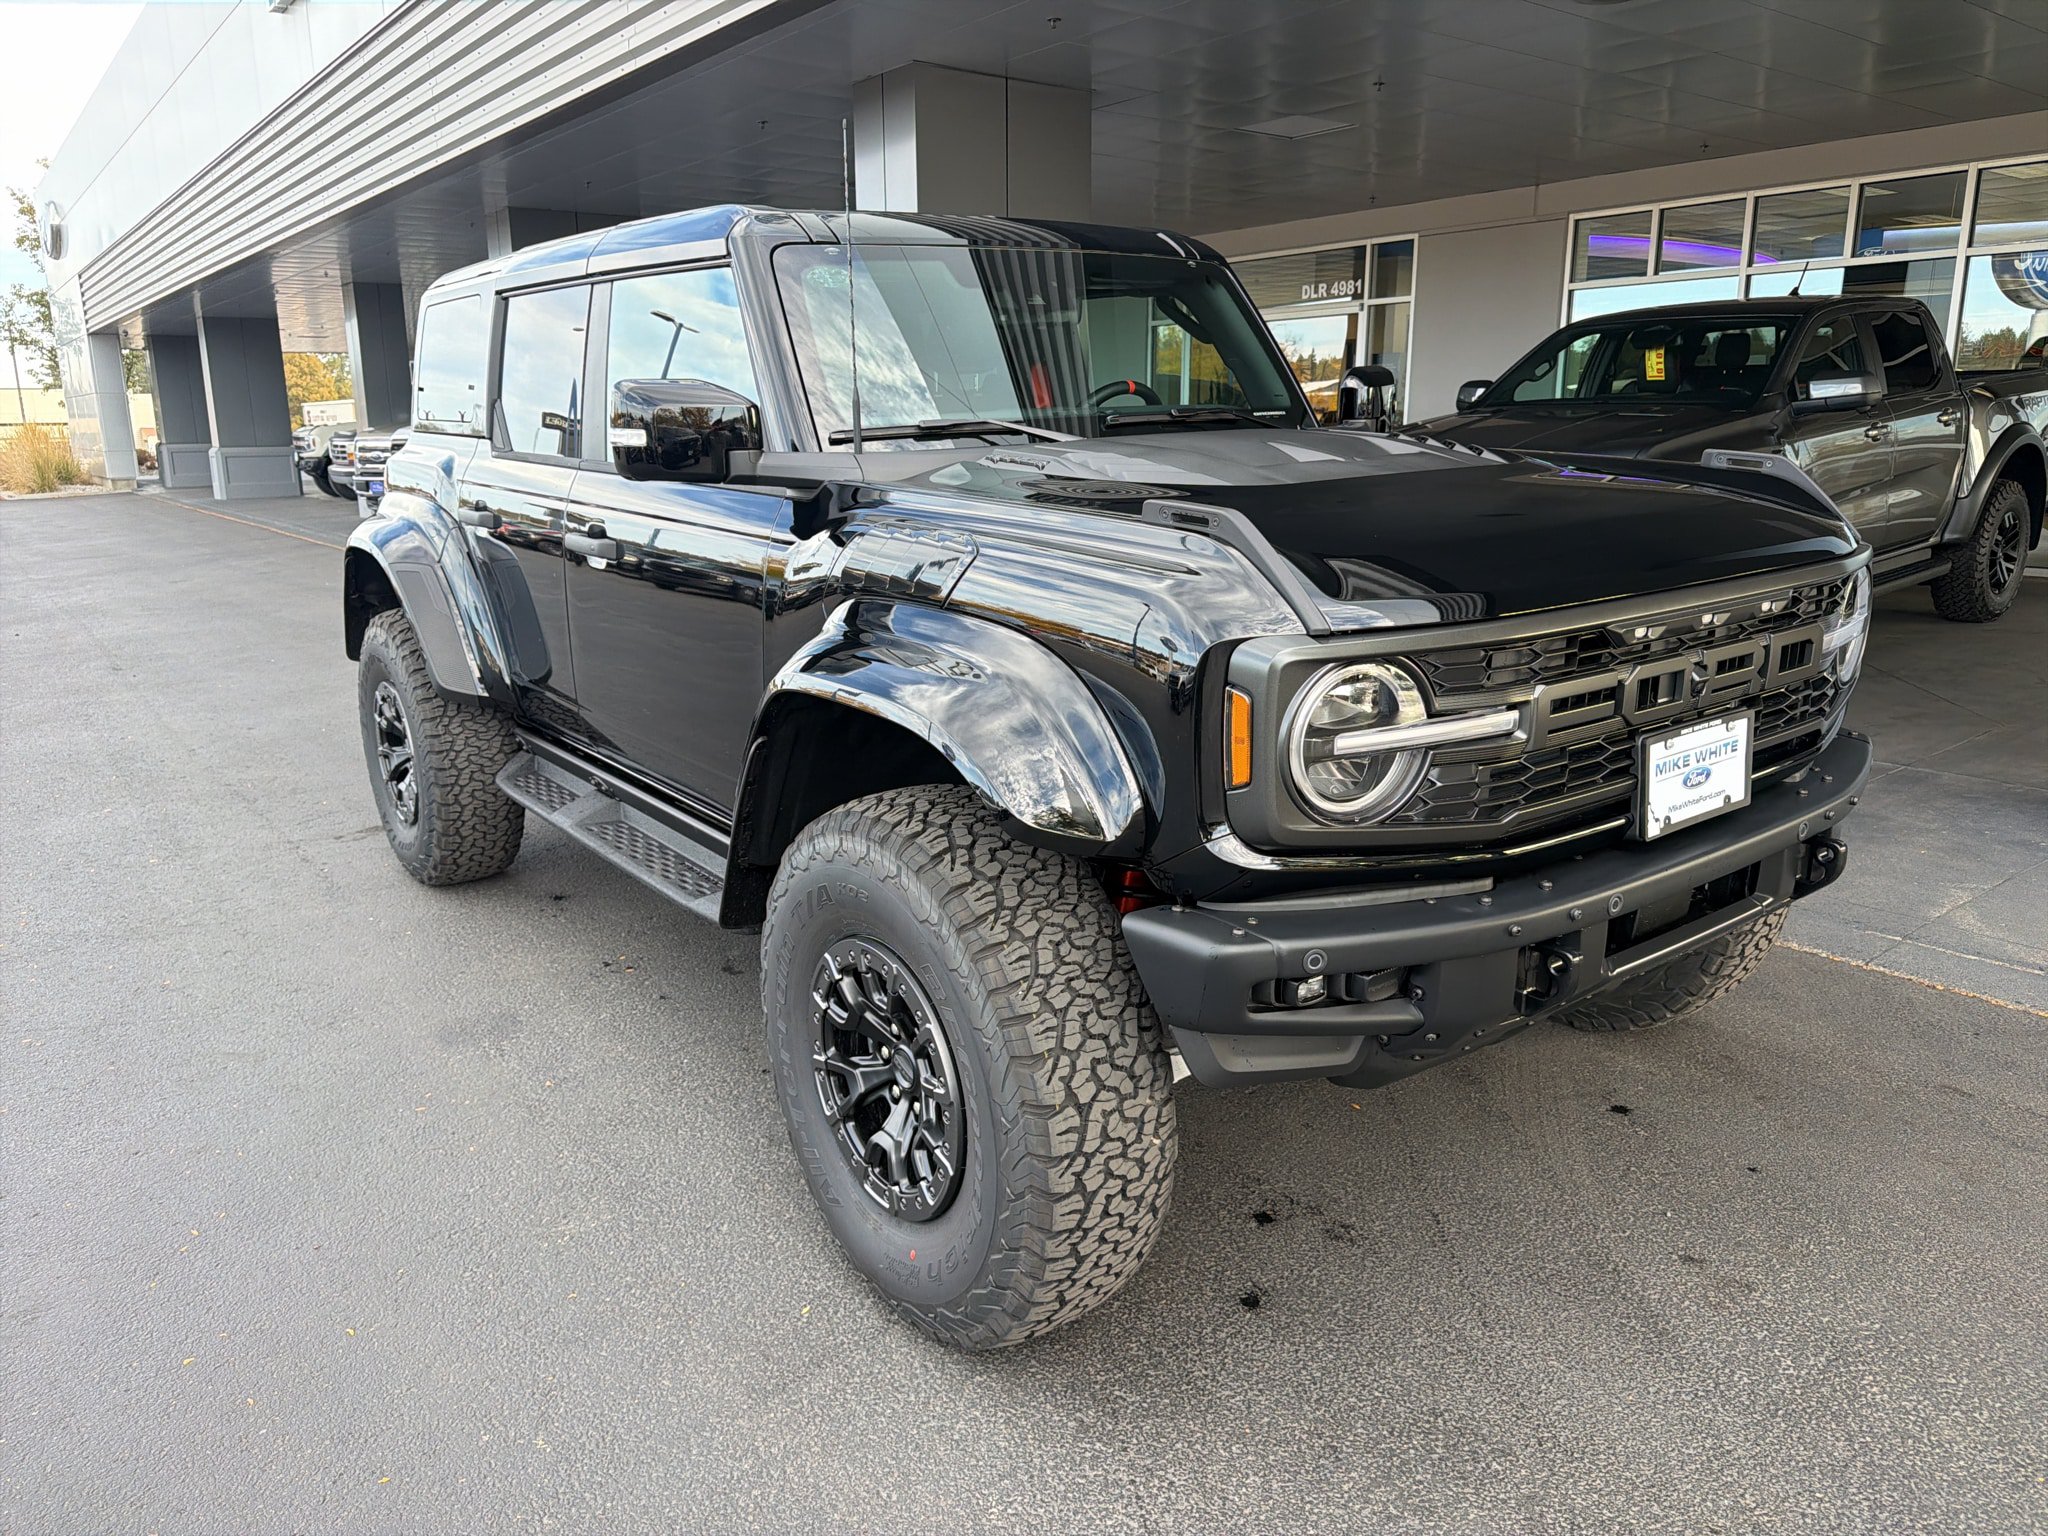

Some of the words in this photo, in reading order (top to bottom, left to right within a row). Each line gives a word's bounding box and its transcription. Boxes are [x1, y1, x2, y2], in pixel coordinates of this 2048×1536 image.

[1301, 283, 1328, 299] DLR
[1330, 278, 1362, 296] 4981
[1524, 620, 1826, 753] FORD
[1655, 754, 1691, 777] MIKE
[1694, 740, 1739, 764] WHITE
[1685, 767, 1708, 787] Ford
[1668, 789, 1726, 814] MikeWhiteFord.com
